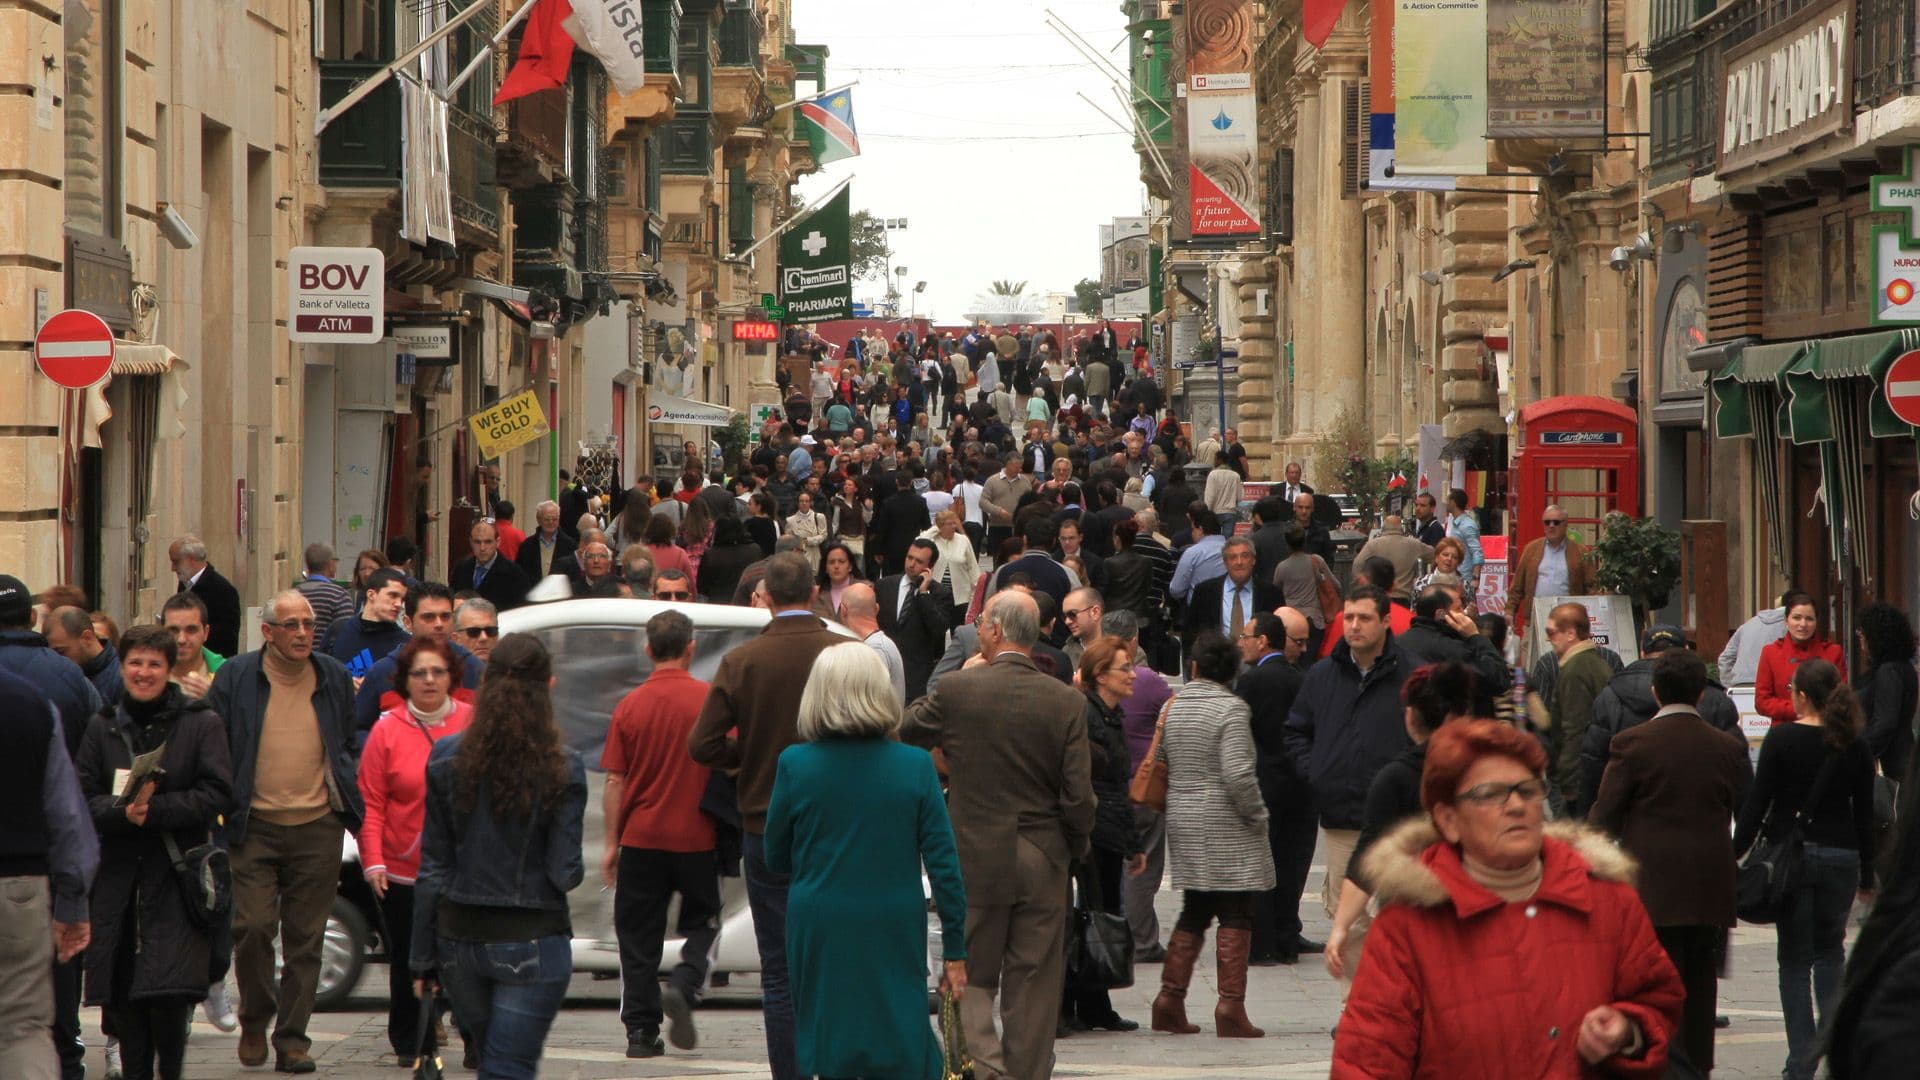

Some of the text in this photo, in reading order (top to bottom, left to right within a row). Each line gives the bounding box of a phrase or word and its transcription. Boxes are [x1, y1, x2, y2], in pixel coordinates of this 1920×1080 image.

[602, 0, 644, 58] ista
[1766, 11, 1847, 136] PHARMACY
[1196, 205, 1232, 218] a future
[1197, 217, 1211, 230] for
[1229, 218, 1249, 229] past
[299, 264, 370, 290] BOV
[299, 299, 370, 309] Bank of Valletta
[788, 296, 848, 313] PHARMACY
[318, 318, 352, 331] ATM
[735, 322, 776, 339] MIMA
[476, 397, 530, 430] WE BUY
[490, 414, 530, 439] GOLD
